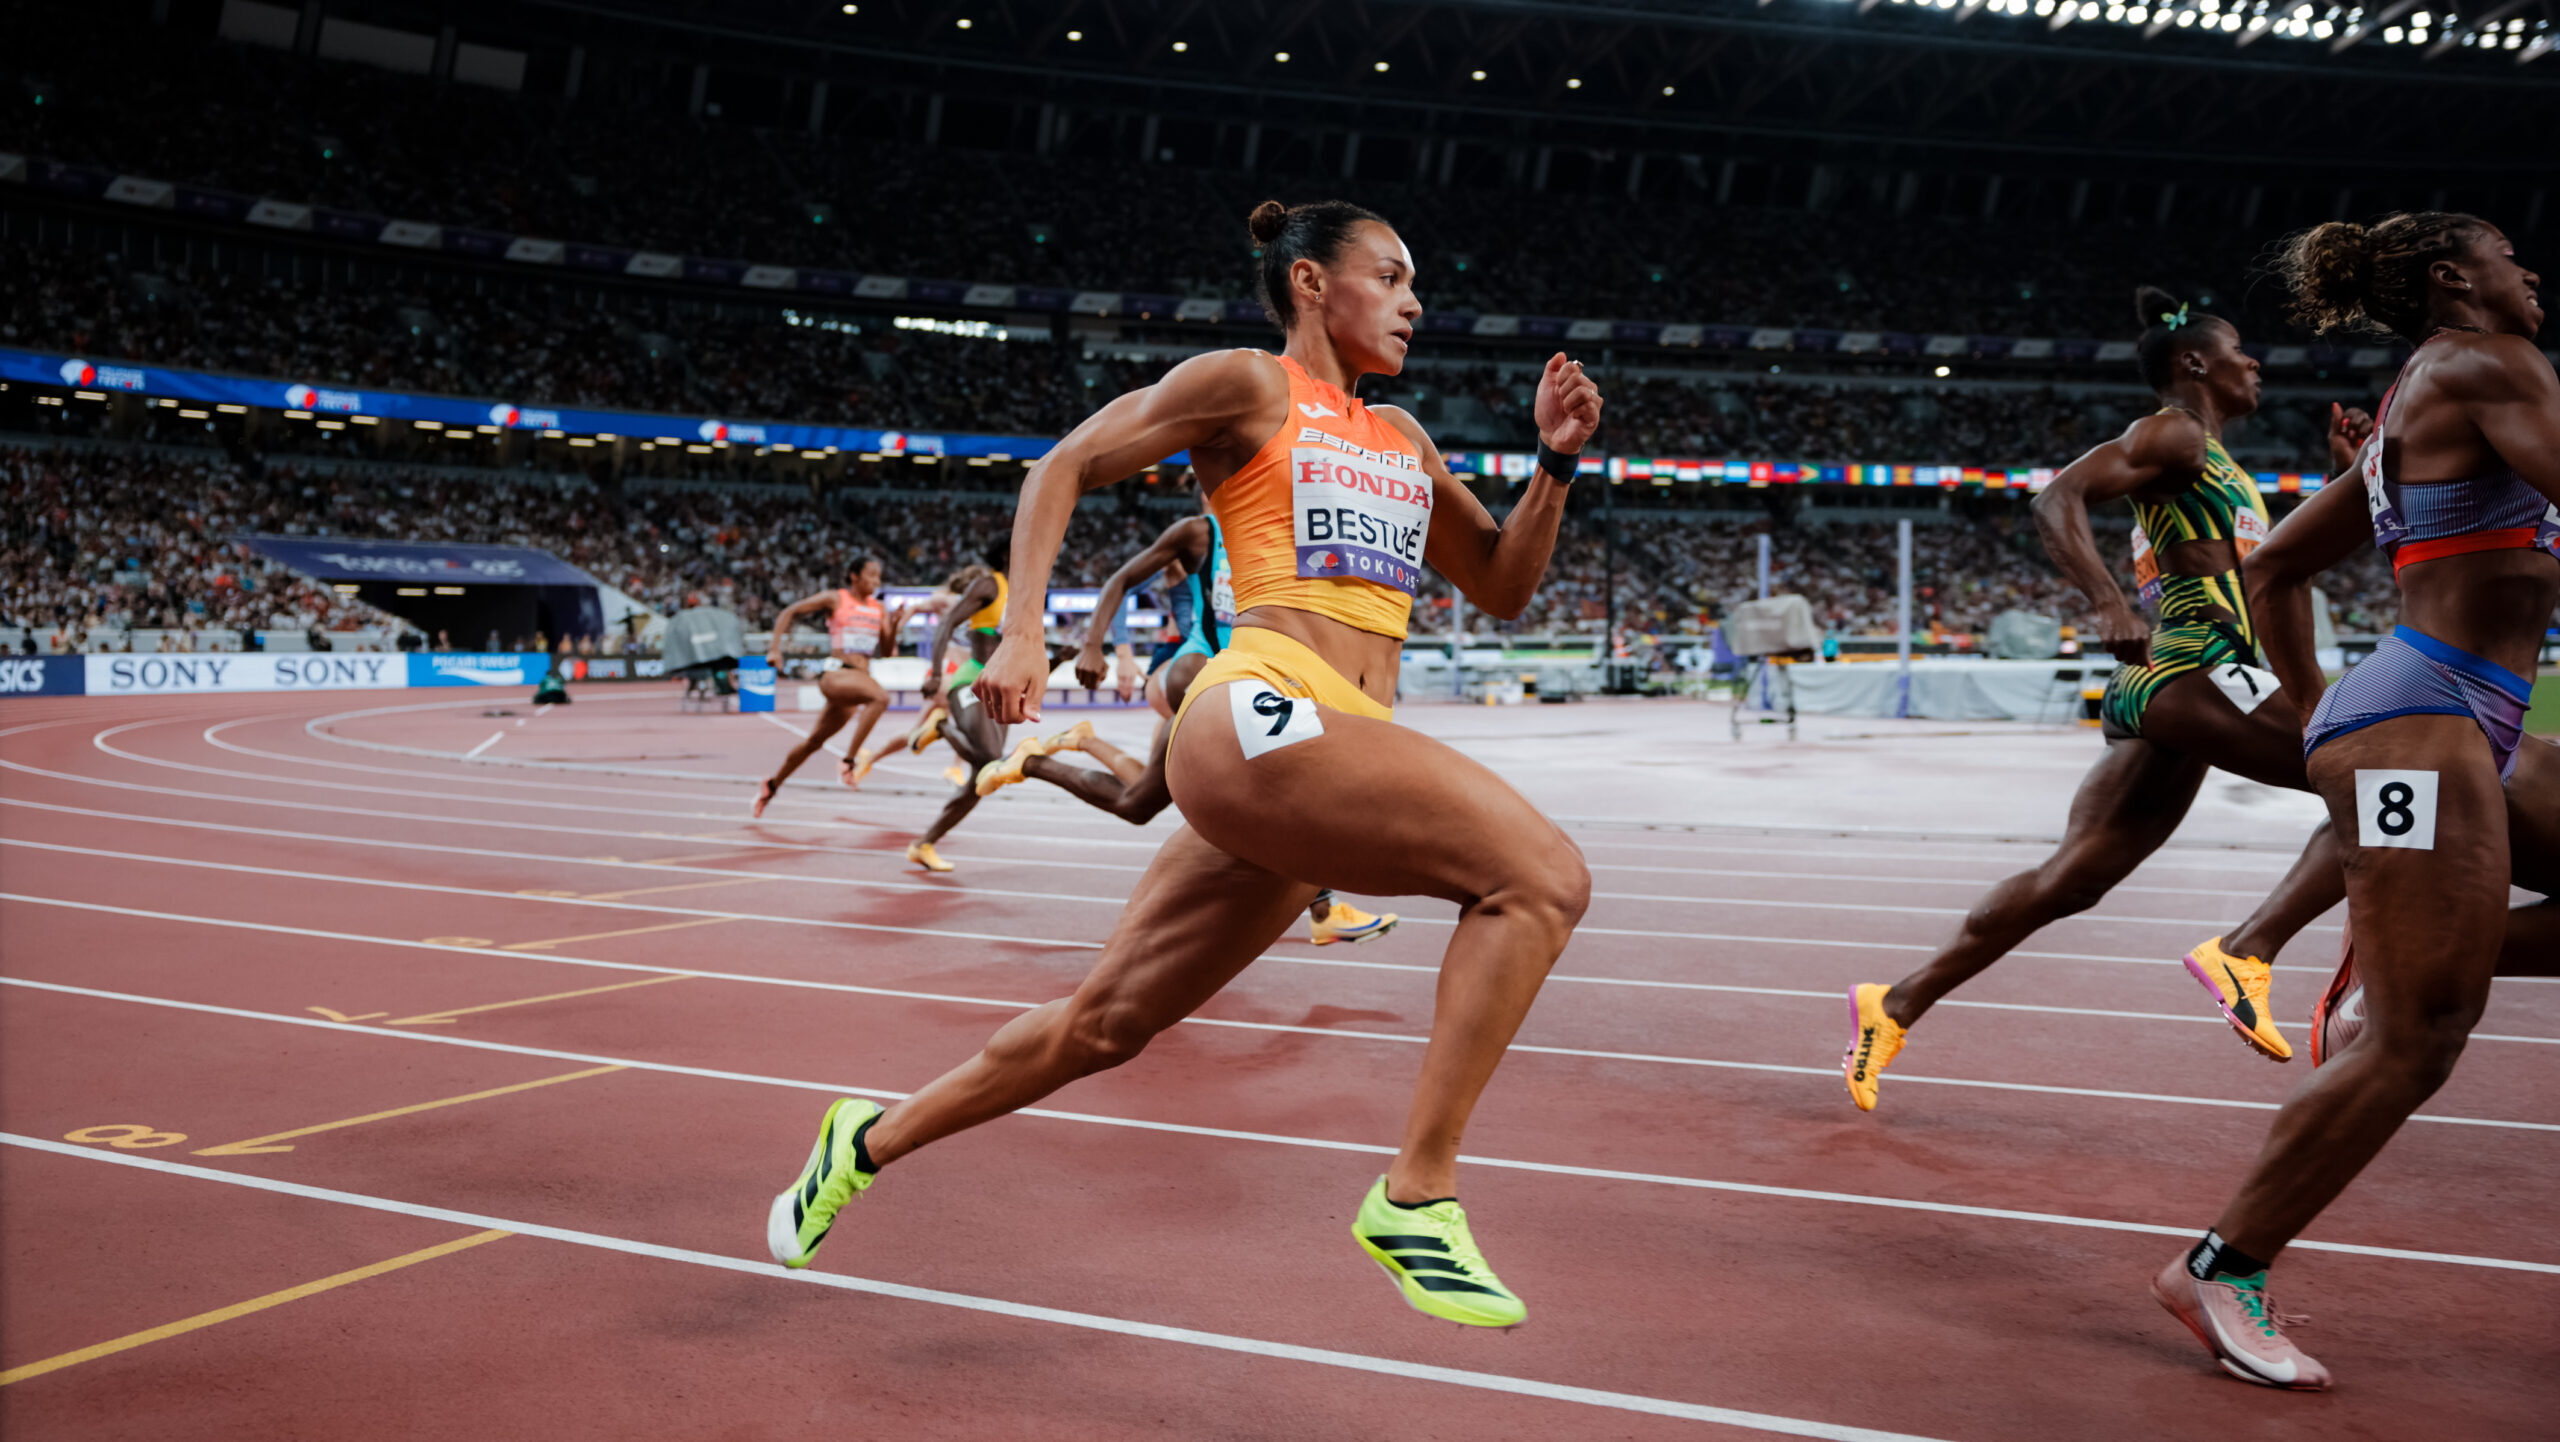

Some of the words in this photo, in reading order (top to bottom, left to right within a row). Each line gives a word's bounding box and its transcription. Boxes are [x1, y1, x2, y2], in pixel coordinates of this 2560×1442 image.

[1297, 426, 1421, 472] ESPAÑA
[1298, 461, 1431, 510] HONDA
[1306, 507, 1422, 562] BESTUÉ
[111, 659, 229, 689] SONY
[274, 657, 386, 687] SONY
[2227, 664, 2259, 697] 7
[1253, 691, 1293, 736] 9
[2377, 781, 2415, 836] 8
[304, 1006, 389, 1023] 7
[1854, 1026, 1875, 1083] NITRO
[63, 1124, 188, 1149] 8
